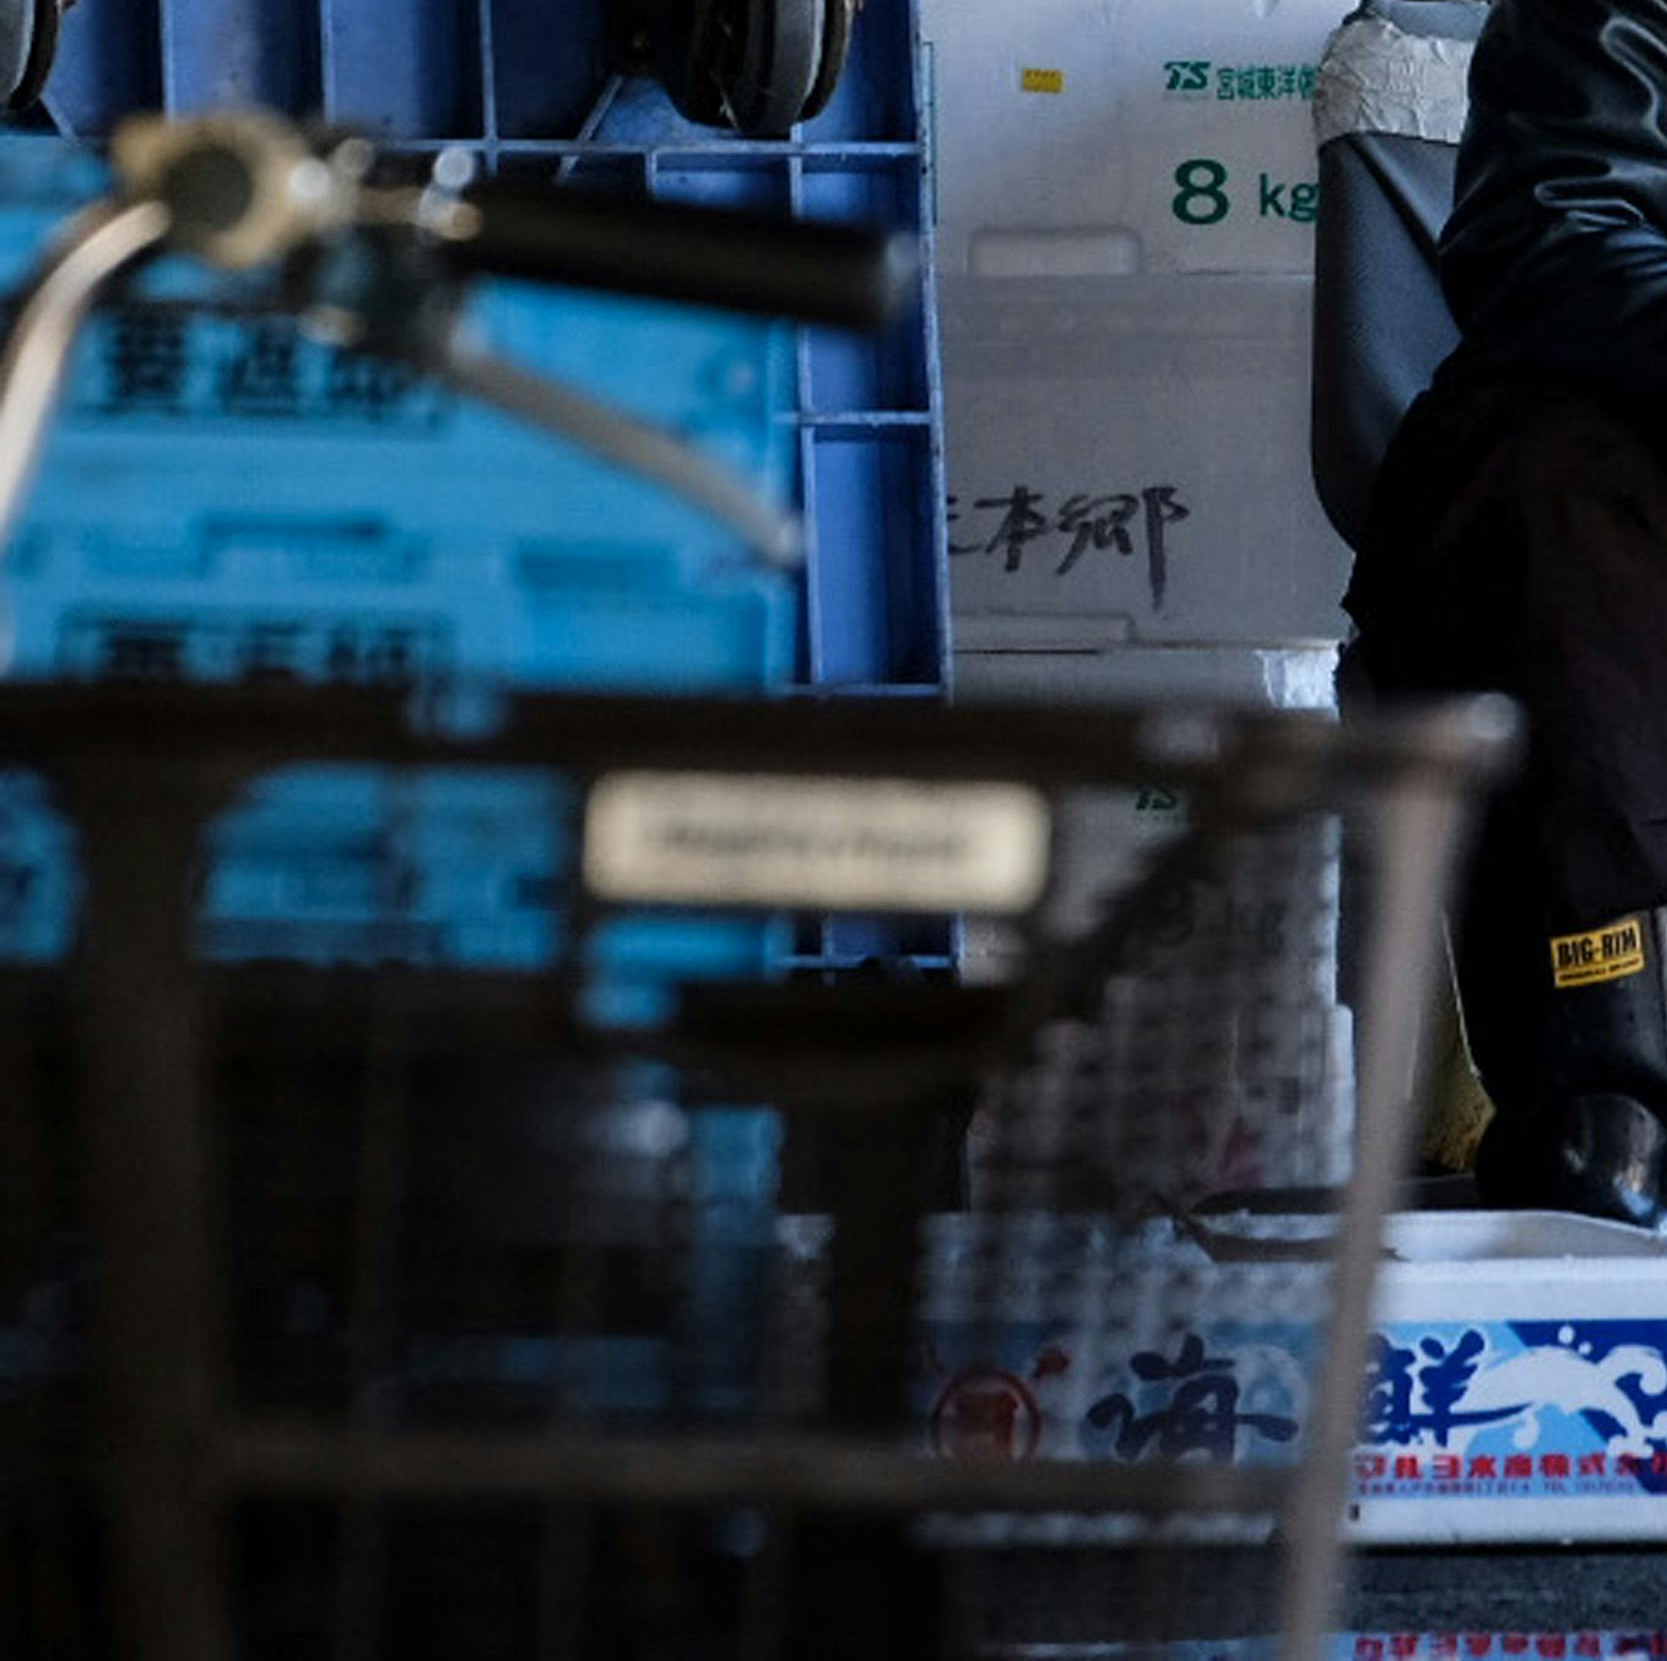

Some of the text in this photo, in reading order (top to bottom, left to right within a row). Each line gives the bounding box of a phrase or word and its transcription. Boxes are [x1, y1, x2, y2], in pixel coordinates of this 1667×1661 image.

[1172, 158, 1320, 225] 8 kg
[1558, 926, 1638, 968] BIG-RIM
